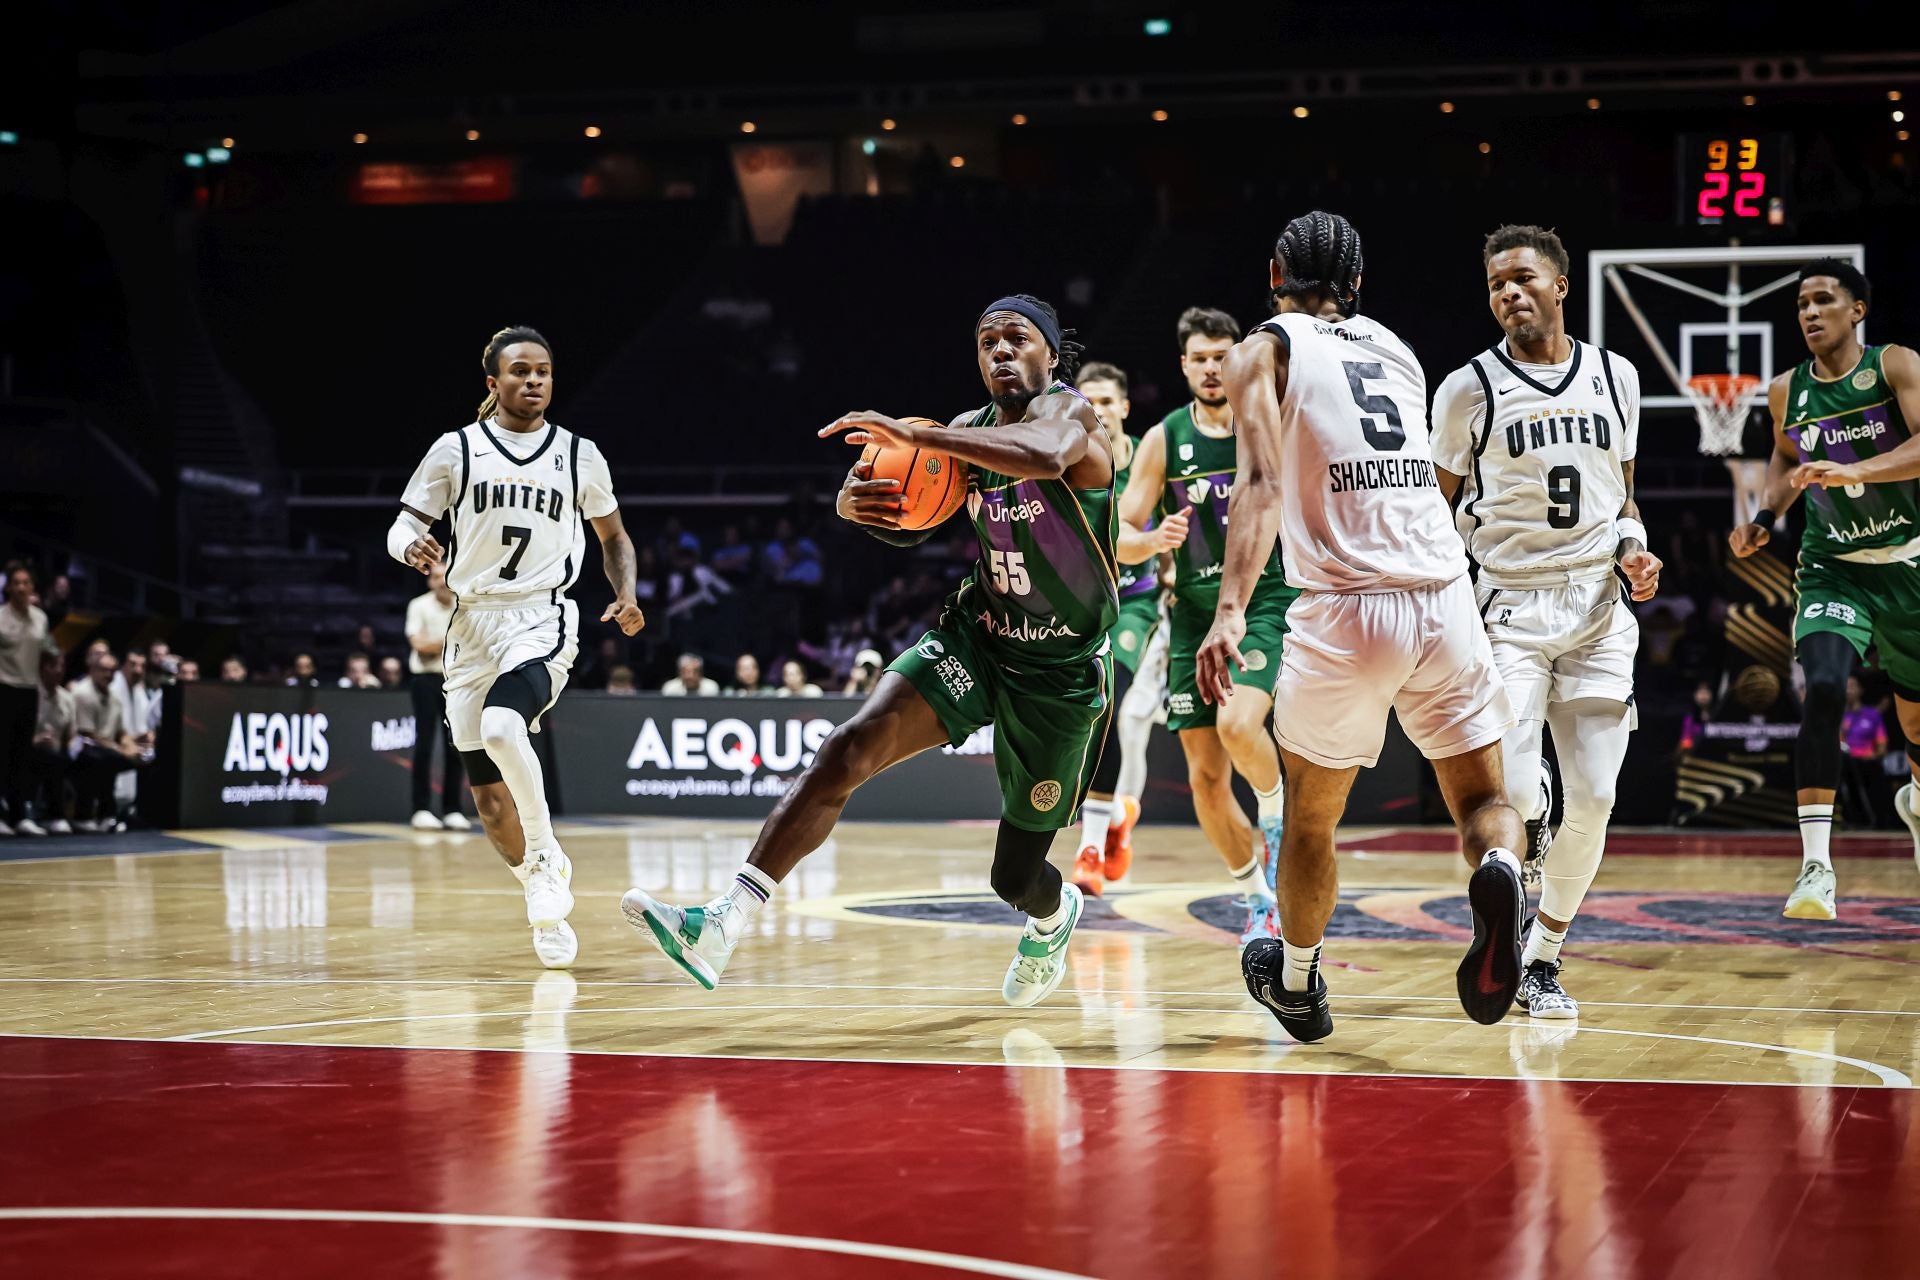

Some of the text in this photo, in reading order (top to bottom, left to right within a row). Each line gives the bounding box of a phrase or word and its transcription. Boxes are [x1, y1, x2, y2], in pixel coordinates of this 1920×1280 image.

[1698, 172, 1765, 217] 22
[1341, 361, 1406, 451] 5
[1506, 412, 1611, 458] UNITED
[1824, 420, 1886, 445] Unicaja
[474, 480, 564, 523] UNITED
[988, 499, 1046, 523] Uncaja
[1547, 465, 1580, 529] 9
[1827, 508, 1912, 543] Andalucía
[499, 525, 532, 580] 7
[990, 550, 1032, 596] 55
[940, 660, 967, 697] DEL SOL
[948, 655, 975, 691] COSTA
[223, 711, 330, 776] AEQUS
[626, 717, 837, 776] AEQUS
